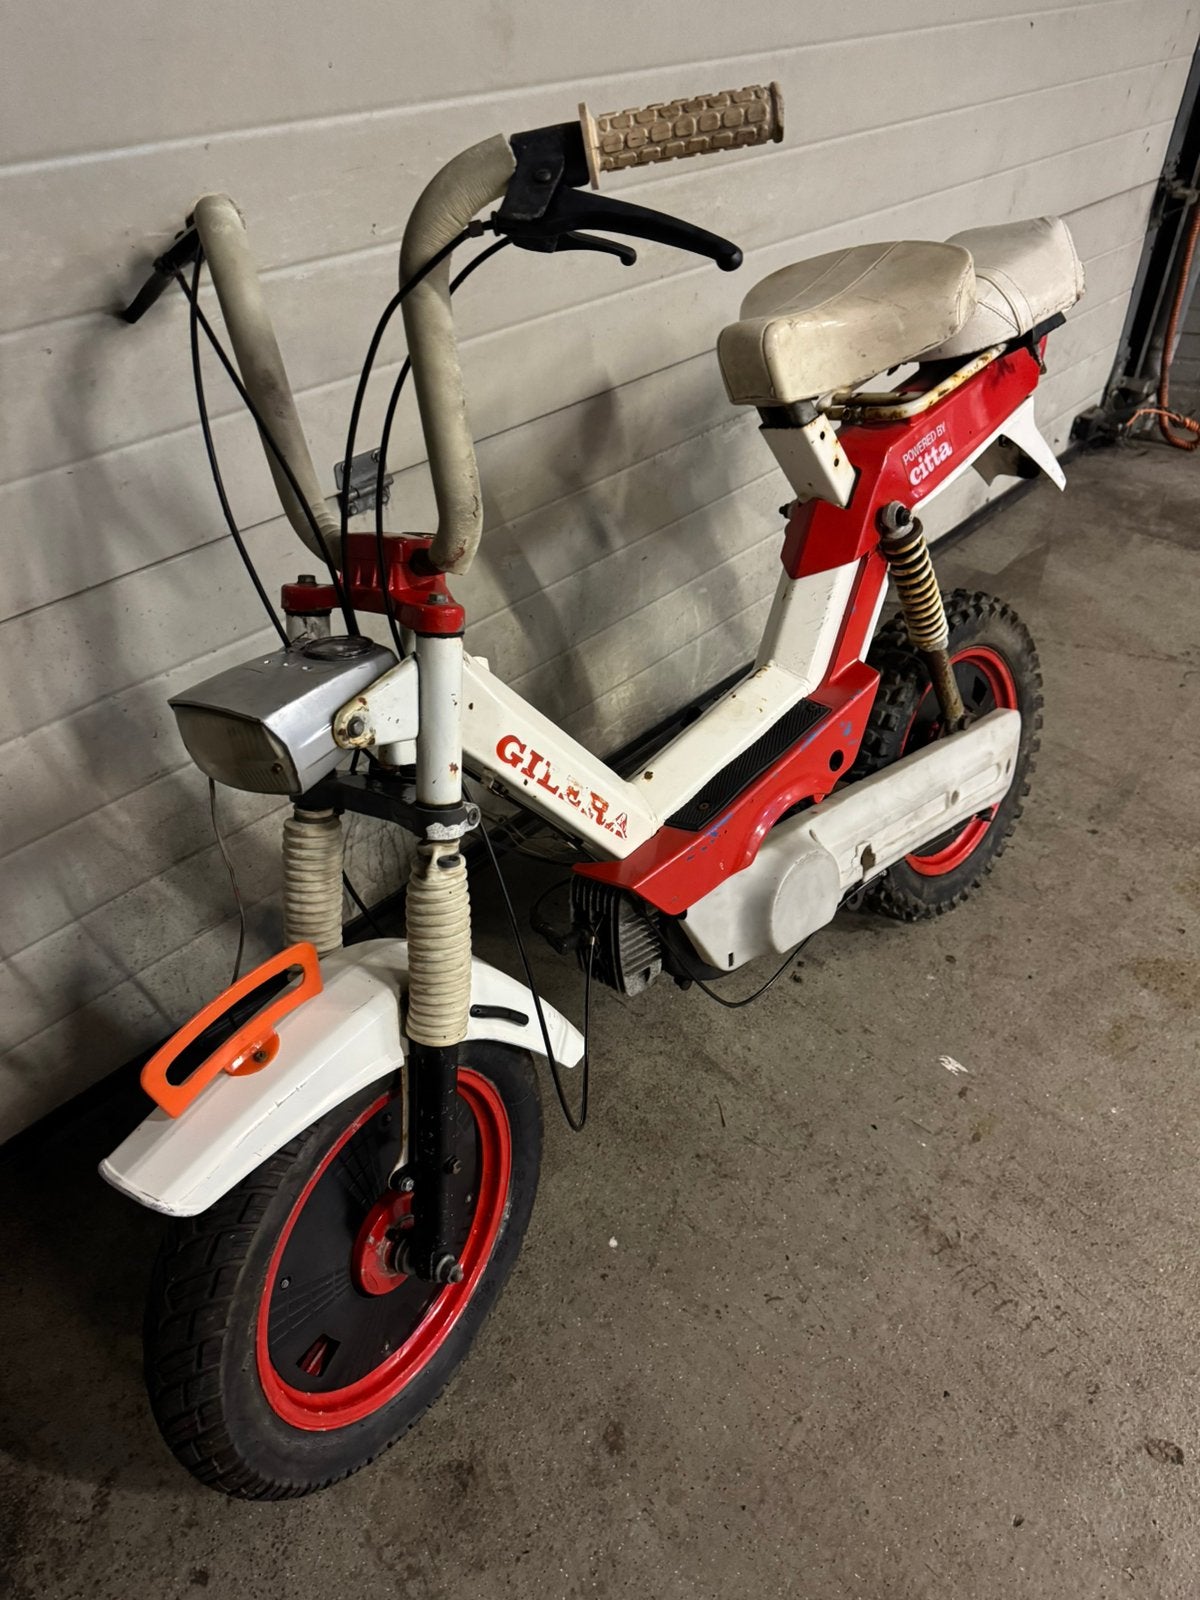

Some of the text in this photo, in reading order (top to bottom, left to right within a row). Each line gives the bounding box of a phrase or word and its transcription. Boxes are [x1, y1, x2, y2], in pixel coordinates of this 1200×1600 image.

[902, 421, 946, 466] POWERED BY
[909, 441, 953, 486] citta
